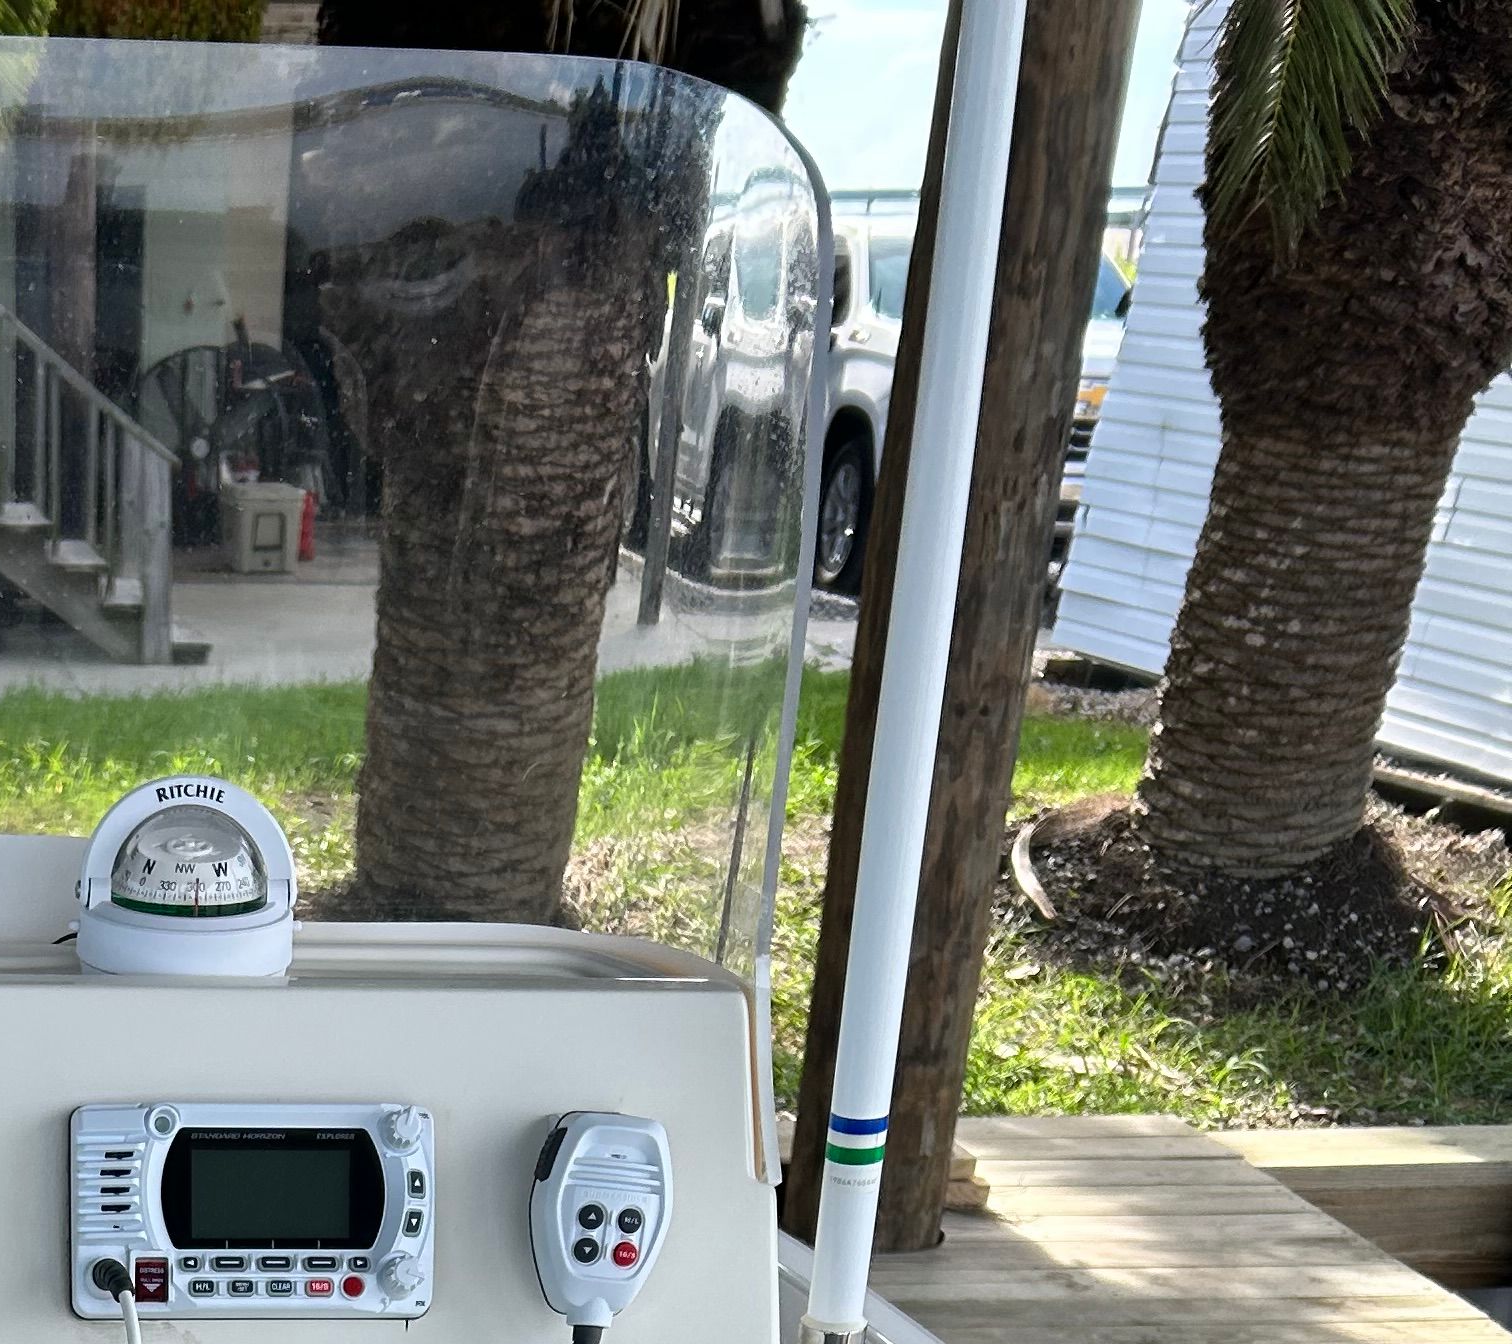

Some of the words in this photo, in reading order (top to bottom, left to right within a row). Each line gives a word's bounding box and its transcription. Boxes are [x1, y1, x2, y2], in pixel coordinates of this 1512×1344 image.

[156, 784, 226, 804] RITCHIE
[142, 859, 157, 875] N
[174, 863, 196, 874] NW
[212, 862, 228, 877] W
[160, 880, 177, 891] 330
[215, 881, 232, 892] 270
[195, 1283, 210, 1291] H/L
[271, 1282, 291, 1290] CLEAR
